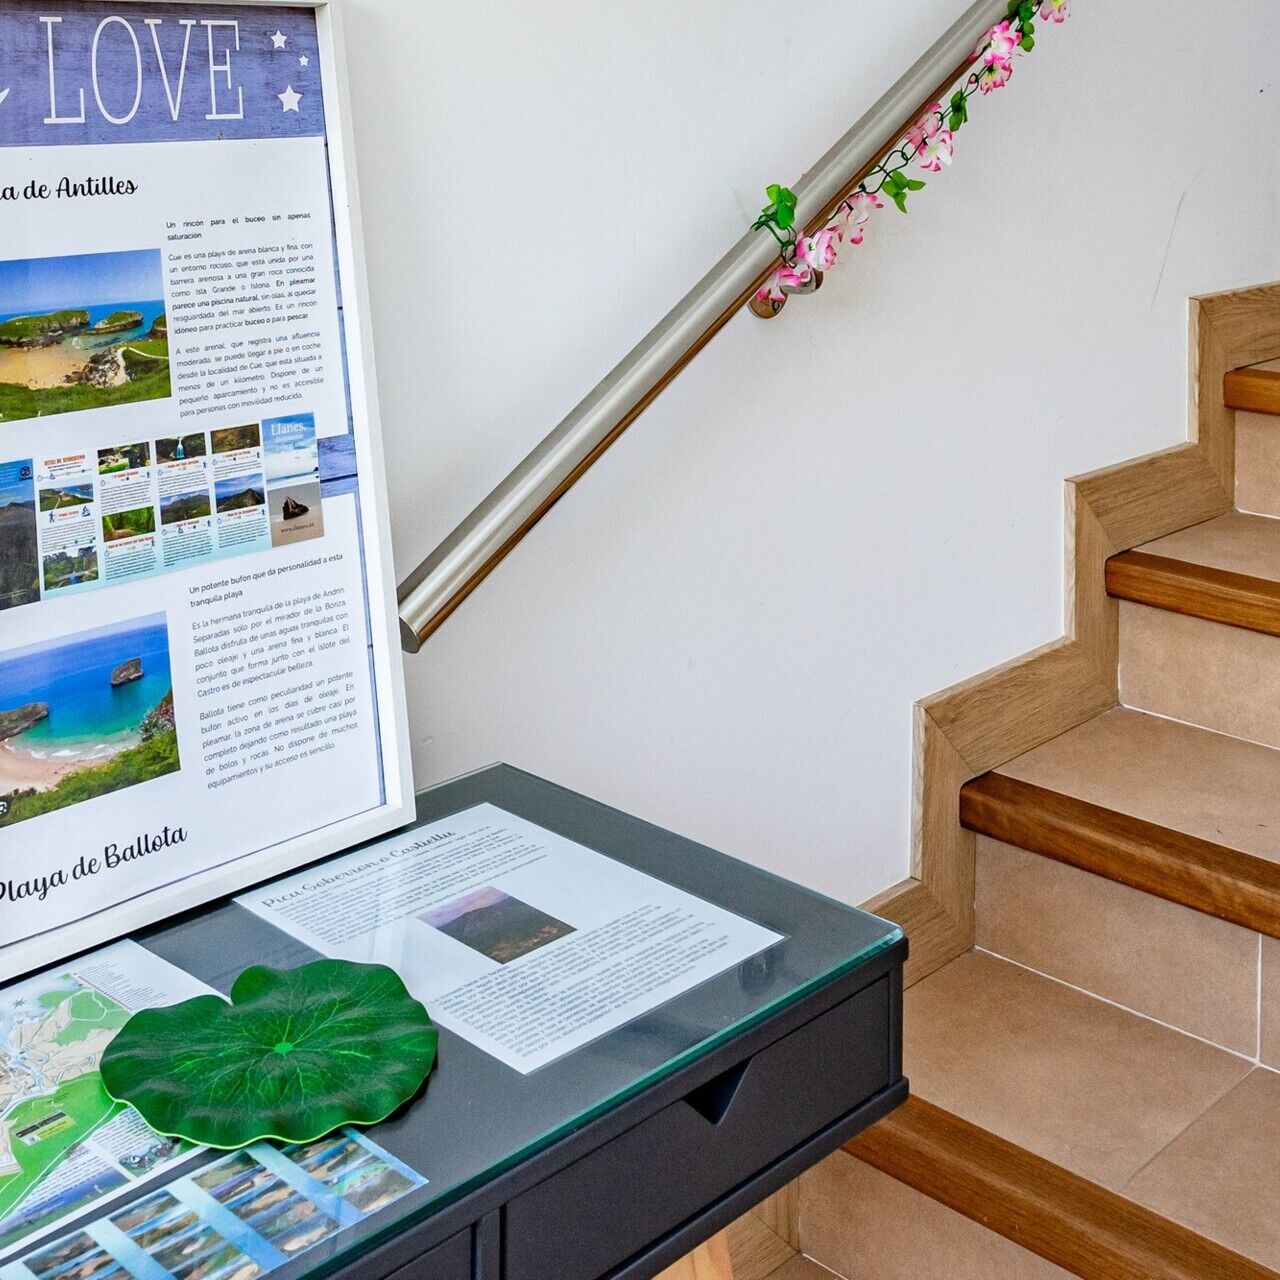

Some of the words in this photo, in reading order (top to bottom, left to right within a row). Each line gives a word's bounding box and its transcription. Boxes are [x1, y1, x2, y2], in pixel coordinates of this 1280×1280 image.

[39, 15, 244, 125] LOVE
[23, 180, 51, 199] de
[55, 176, 138, 198] Antilles
[211, 218, 225, 227] para
[232, 216, 240, 224] el
[288, 212, 311, 221] apenas
[168, 253, 183, 261] Cue
[236, 260, 250, 268] que
[268, 256, 285, 264] unida
[288, 256, 300, 264] por
[170, 277, 194, 285] barrera
[198, 274, 224, 282] arenosa
[250, 270, 265, 279] gran
[286, 265, 314, 274] conocida
[212, 285, 236, 293] Grande
[276, 279, 286, 287] En
[289, 277, 315, 287] pleamar
[172, 301, 196, 311] parece
[211, 297, 234, 307] piscina
[288, 289, 294, 298] al
[173, 311, 215, 322] resguardada
[218, 309, 230, 317] del
[275, 303, 284, 311] Es
[199, 324, 214, 334] para
[215, 320, 243, 331] practicar
[245, 318, 265, 326] buceo
[272, 315, 286, 324] para
[185, 346, 200, 354] este
[231, 341, 245, 349] que
[248, 337, 272, 346] registra
[224, 352, 245, 362] puede
[273, 347, 285, 356] pie
[302, 342, 321, 351] coche
[177, 370, 199, 380] desde
[208, 365, 238, 375] localidad
[265, 360, 278, 368] que
[178, 383, 201, 391] menos
[271, 370, 296, 379] Dispone
[180, 409, 195, 418] para
[196, 404, 226, 415] personas
[241, 396, 273, 407] movilidad
[274, 392, 302, 402] reducida.
[189, 585, 201, 594] Un
[201, 579, 229, 593] potente
[252, 571, 267, 580] que
[267, 568, 277, 576] da
[278, 557, 322, 575] personalidad
[329, 554, 343, 562] esta
[190, 594, 222, 607] tranquila
[192, 620, 202, 630] Es
[210, 612, 242, 625] hermana
[243, 604, 273, 617] tranquila
[193, 628, 230, 643] Separadas
[251, 620, 263, 630] por
[275, 611, 300, 622] mirador
[194, 644, 219, 656] Ballota
[260, 630, 277, 640] unas
[279, 624, 299, 636] aguas
[301, 616, 334, 629] tranquilas
[336, 613, 349, 621] con
[195, 660, 213, 672] poco
[217, 652, 239, 664] oleaje
[251, 646, 265, 655] una
[268, 641, 287, 651] arena
[291, 636, 303, 644] fina
[196, 669, 227, 684] conjunto
[231, 665, 245, 677] que
[248, 659, 268, 669] forma
[271, 652, 289, 665] junto
[292, 649, 306, 658] con
[339, 636, 351, 646] del
[197, 685, 221, 697] Castro
[242, 667, 286, 685] espectacular
[200, 707, 224, 720] Ballota
[227, 701, 245, 712] tiene
[248, 695, 268, 706] como
[328, 672, 353, 685] potente
[227, 714, 248, 726] activo
[268, 705, 280, 714] los
[244, 724, 260, 735] zona
[275, 714, 294, 725] arena
[344, 697, 356, 707] por
[204, 745, 237, 761] completo
[239, 735, 267, 750] dejando
[269, 730, 289, 741] como
[291, 719, 322, 734] resultado
[324, 715, 338, 724] una
[219, 758, 238, 770] bolos
[274, 744, 285, 752] No
[288, 735, 315, 749] dispone
[332, 722, 358, 736] muchos
[72, 856, 101, 880] de
[104, 826, 188, 868] Ballota
